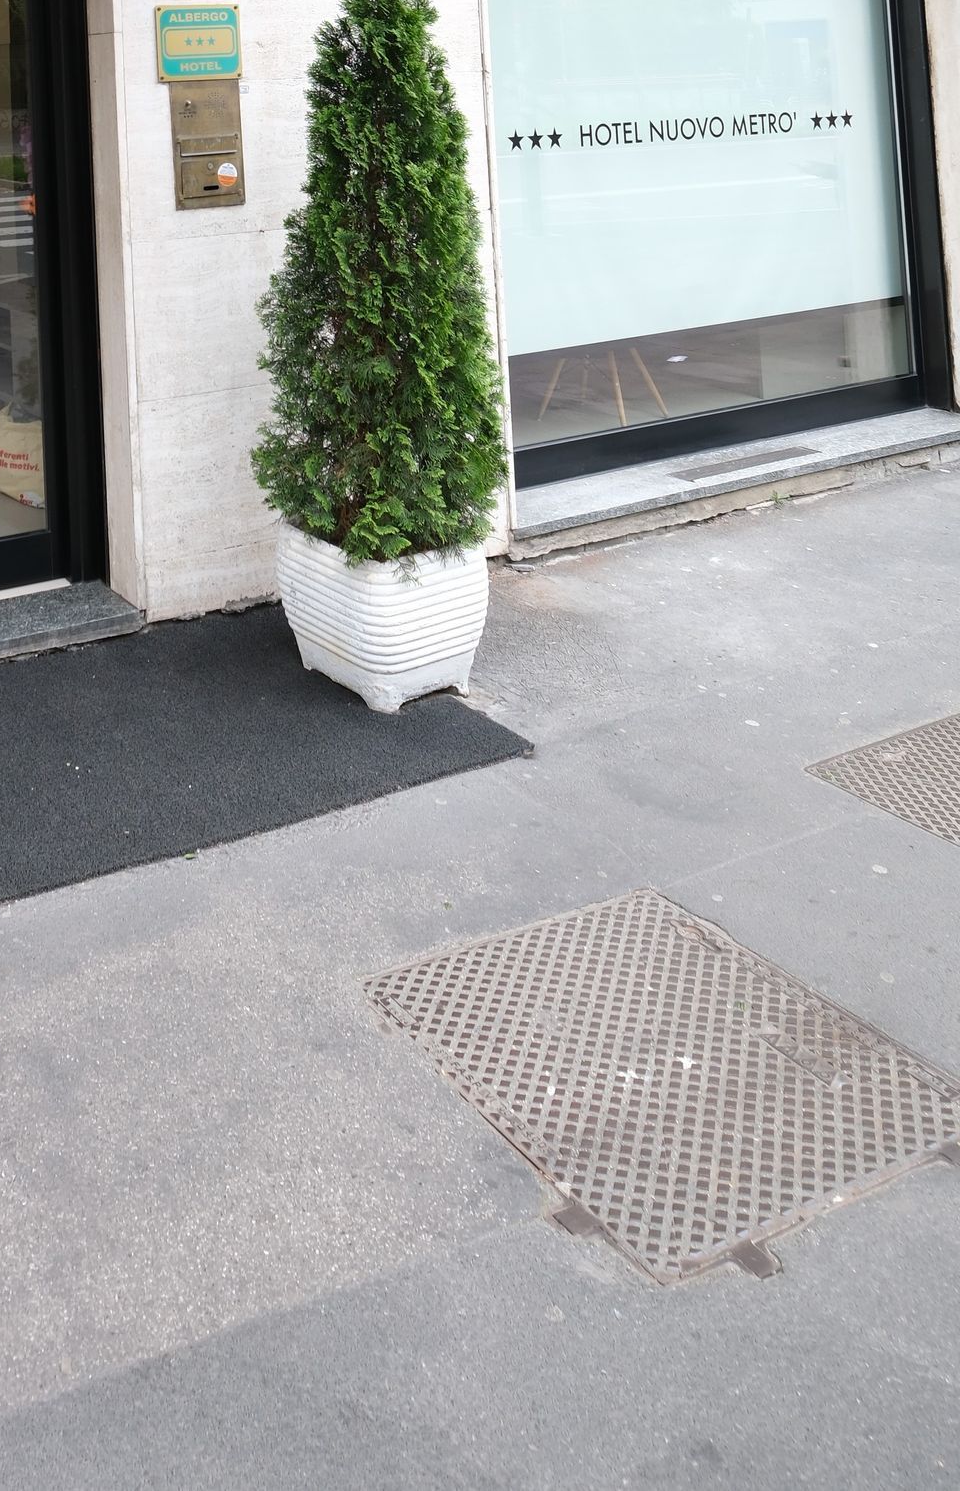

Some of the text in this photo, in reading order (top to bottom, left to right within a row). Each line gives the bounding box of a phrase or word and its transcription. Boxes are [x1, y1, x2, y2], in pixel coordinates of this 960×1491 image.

[169, 12, 228, 23] ALBERGO
[180, 60, 222, 73] HOTEL
[578, 110, 798, 148] HOTEL NUOVO METRO'
